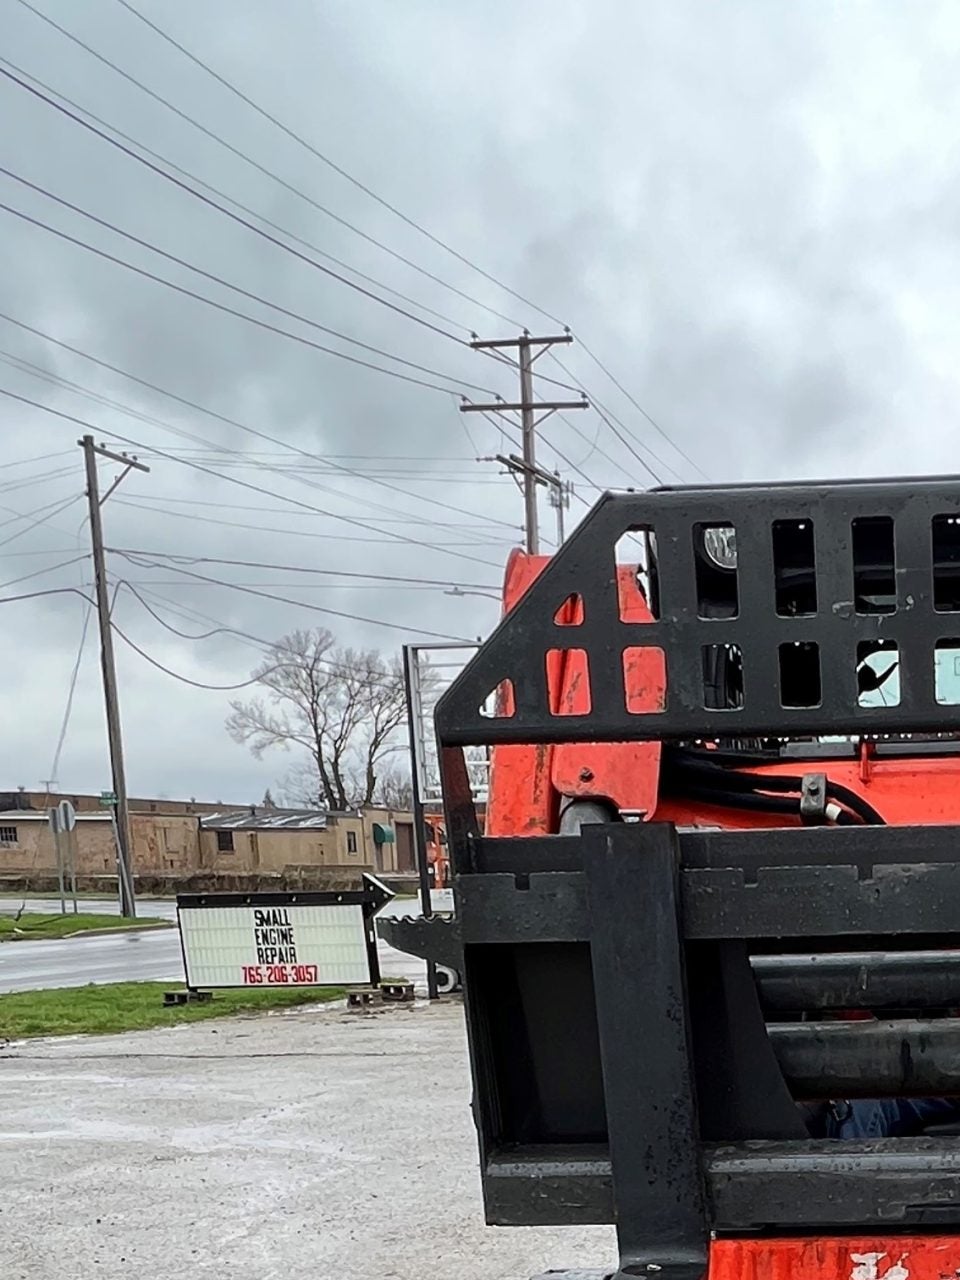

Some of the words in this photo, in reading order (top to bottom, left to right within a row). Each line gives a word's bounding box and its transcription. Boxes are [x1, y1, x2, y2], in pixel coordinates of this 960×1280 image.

[254, 909, 291, 927] SMALL
[254, 928, 295, 945] ENGINE
[257, 947, 297, 965] REPAIR
[241, 965, 318, 984] 765-206-3057
